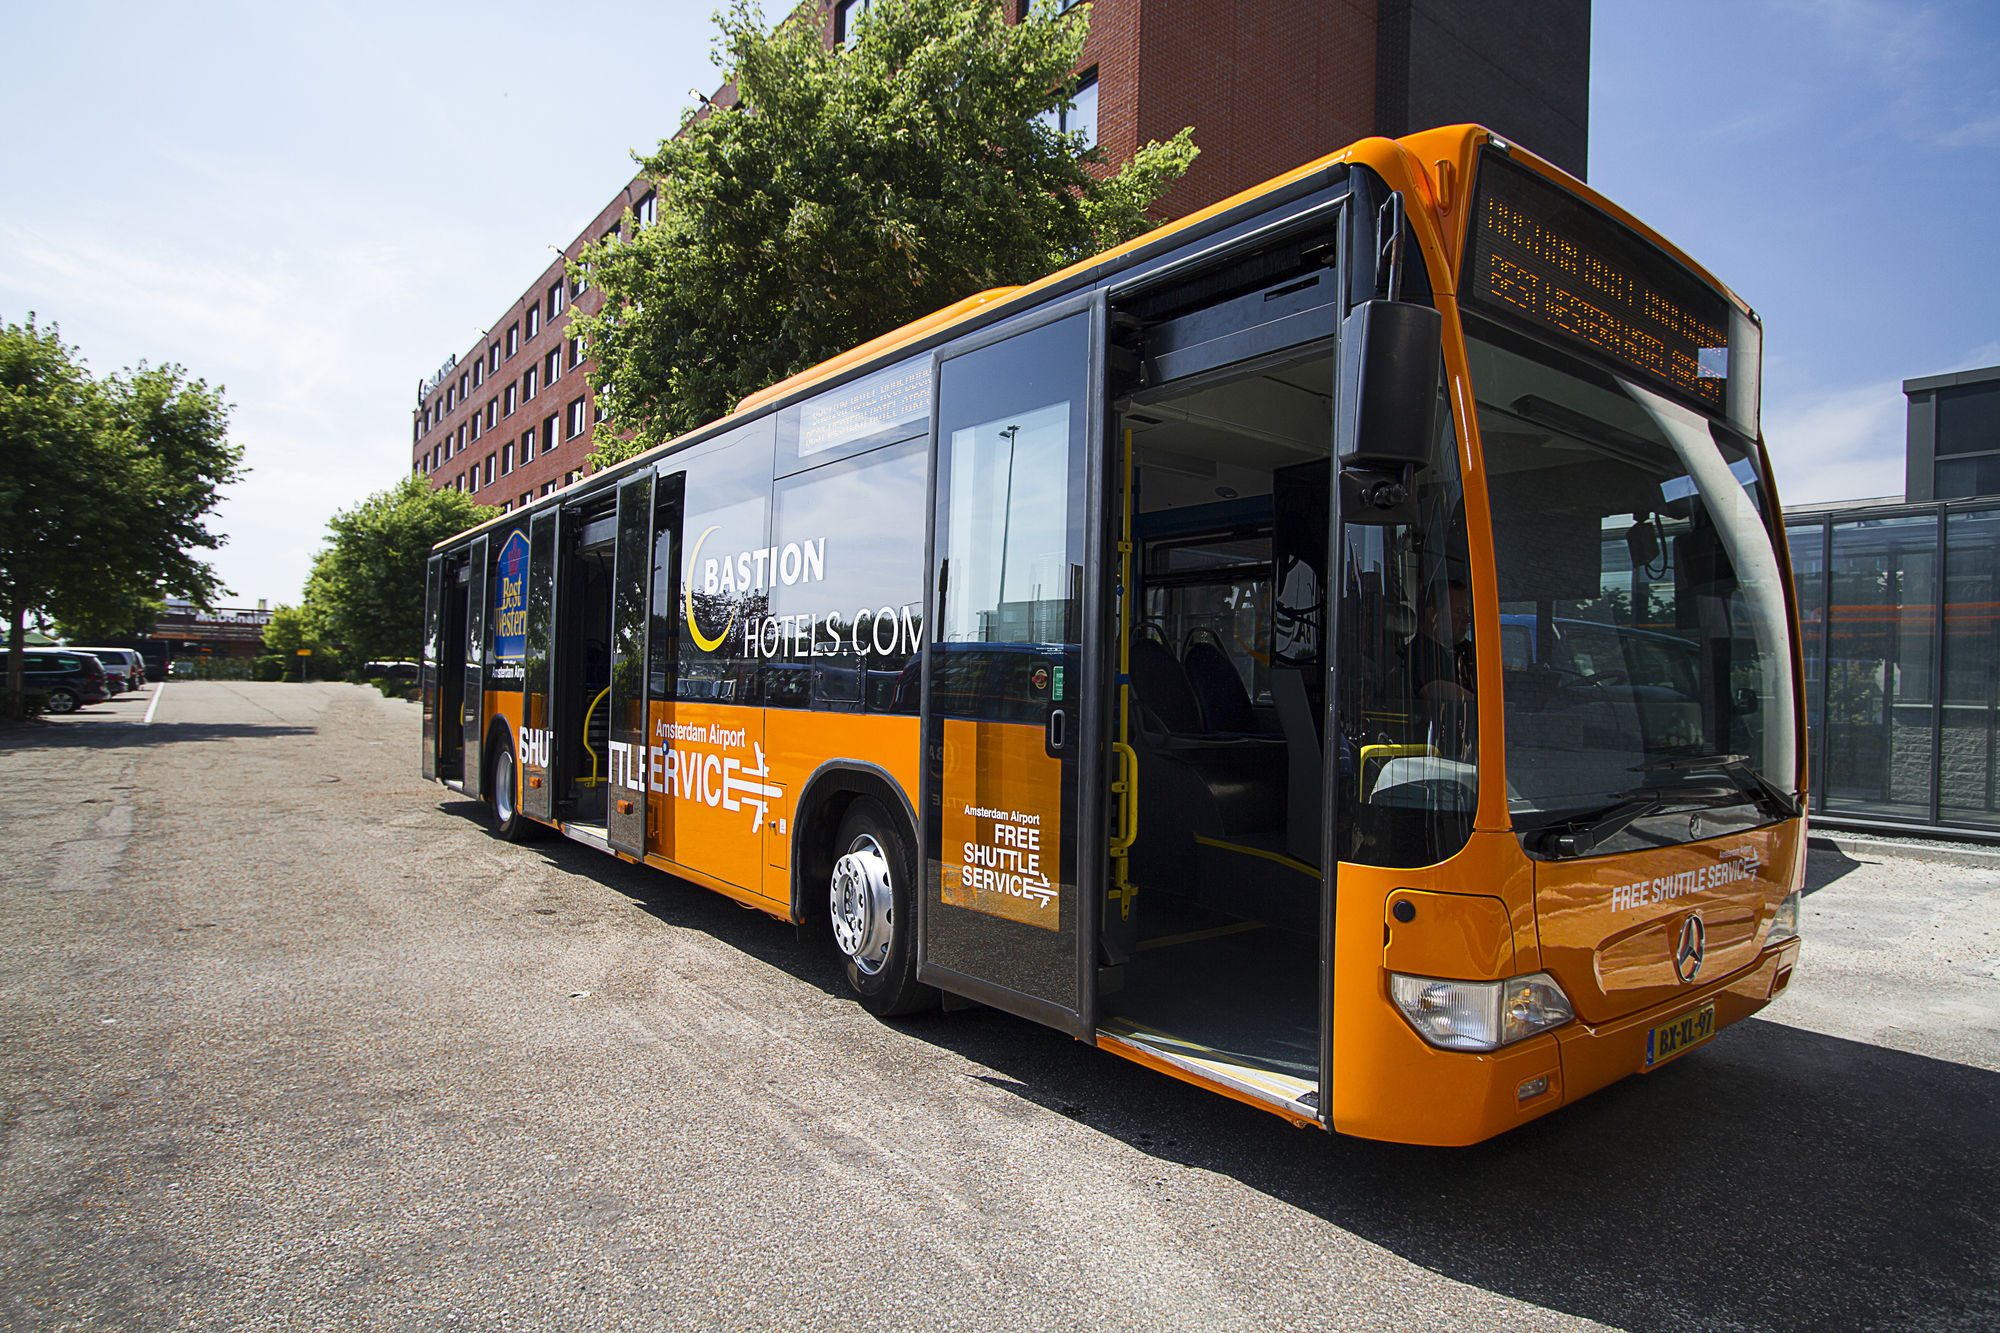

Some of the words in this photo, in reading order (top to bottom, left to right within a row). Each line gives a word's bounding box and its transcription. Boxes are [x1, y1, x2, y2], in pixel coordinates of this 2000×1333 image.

[1491, 253, 1540, 313] BEST
[1545, 281, 1620, 355] WESTERN
[704, 537, 826, 595] BASTION
[502, 573, 522, 609] Best
[195, 613, 274, 625] McDonald
[495, 606, 527, 637] Western
[656, 718, 707, 744] Amsterdam
[708, 723, 746, 751] Airport
[964, 804, 1008, 821] Amsterdam
[1010, 810, 1040, 826] Airport
[994, 823, 1040, 851] FREE
[963, 842, 1040, 877] SHUTTLE
[962, 865, 1035, 900] SERVICE
[1611, 880, 1650, 913] FREE
[1651, 867, 1707, 903] SHUTTLE
[1707, 858, 1750, 889] SERVICE
